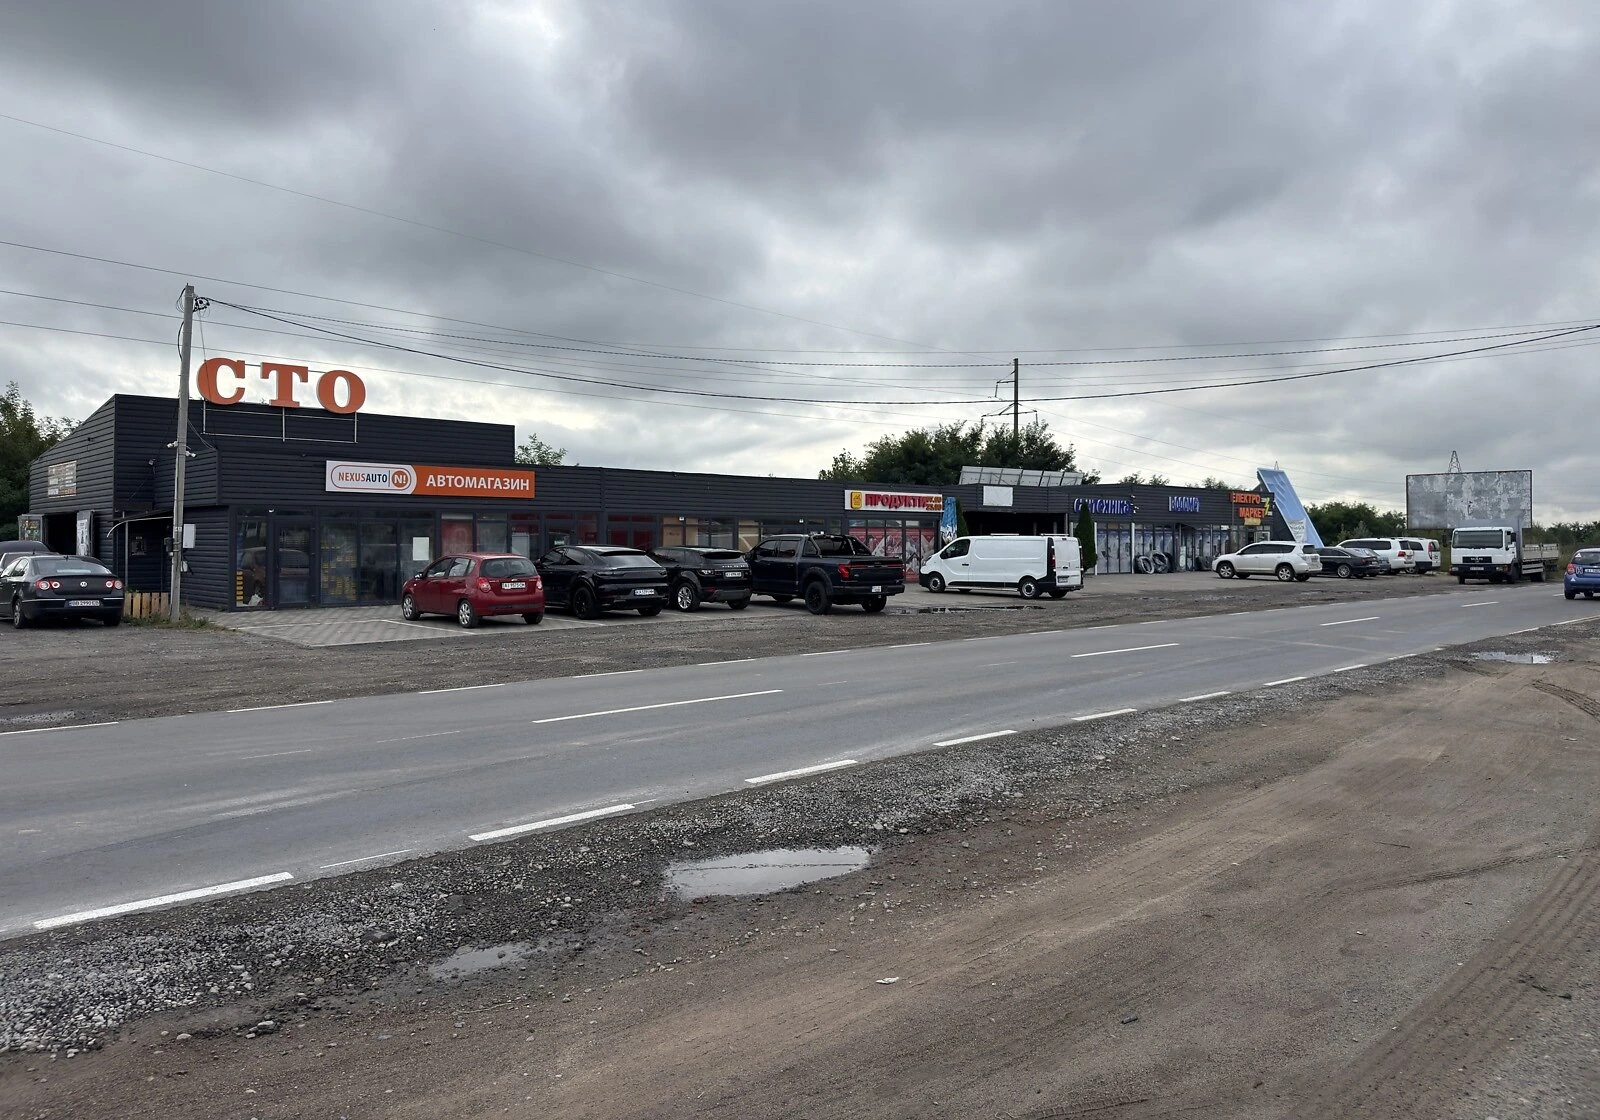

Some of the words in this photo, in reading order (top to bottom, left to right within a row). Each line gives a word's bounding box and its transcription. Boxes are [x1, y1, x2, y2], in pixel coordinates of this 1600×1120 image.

[196, 357, 366, 414] СТО
[338, 471, 388, 483] NEXUSAUTO
[426, 474, 530, 491] АВТОМАГАЗИН
[865, 493, 929, 509] ПРОДУКТИ
[1231, 493, 1261, 504] ЕЛЕКТРО
[1239, 507, 1265, 519] МАРКЕТ
